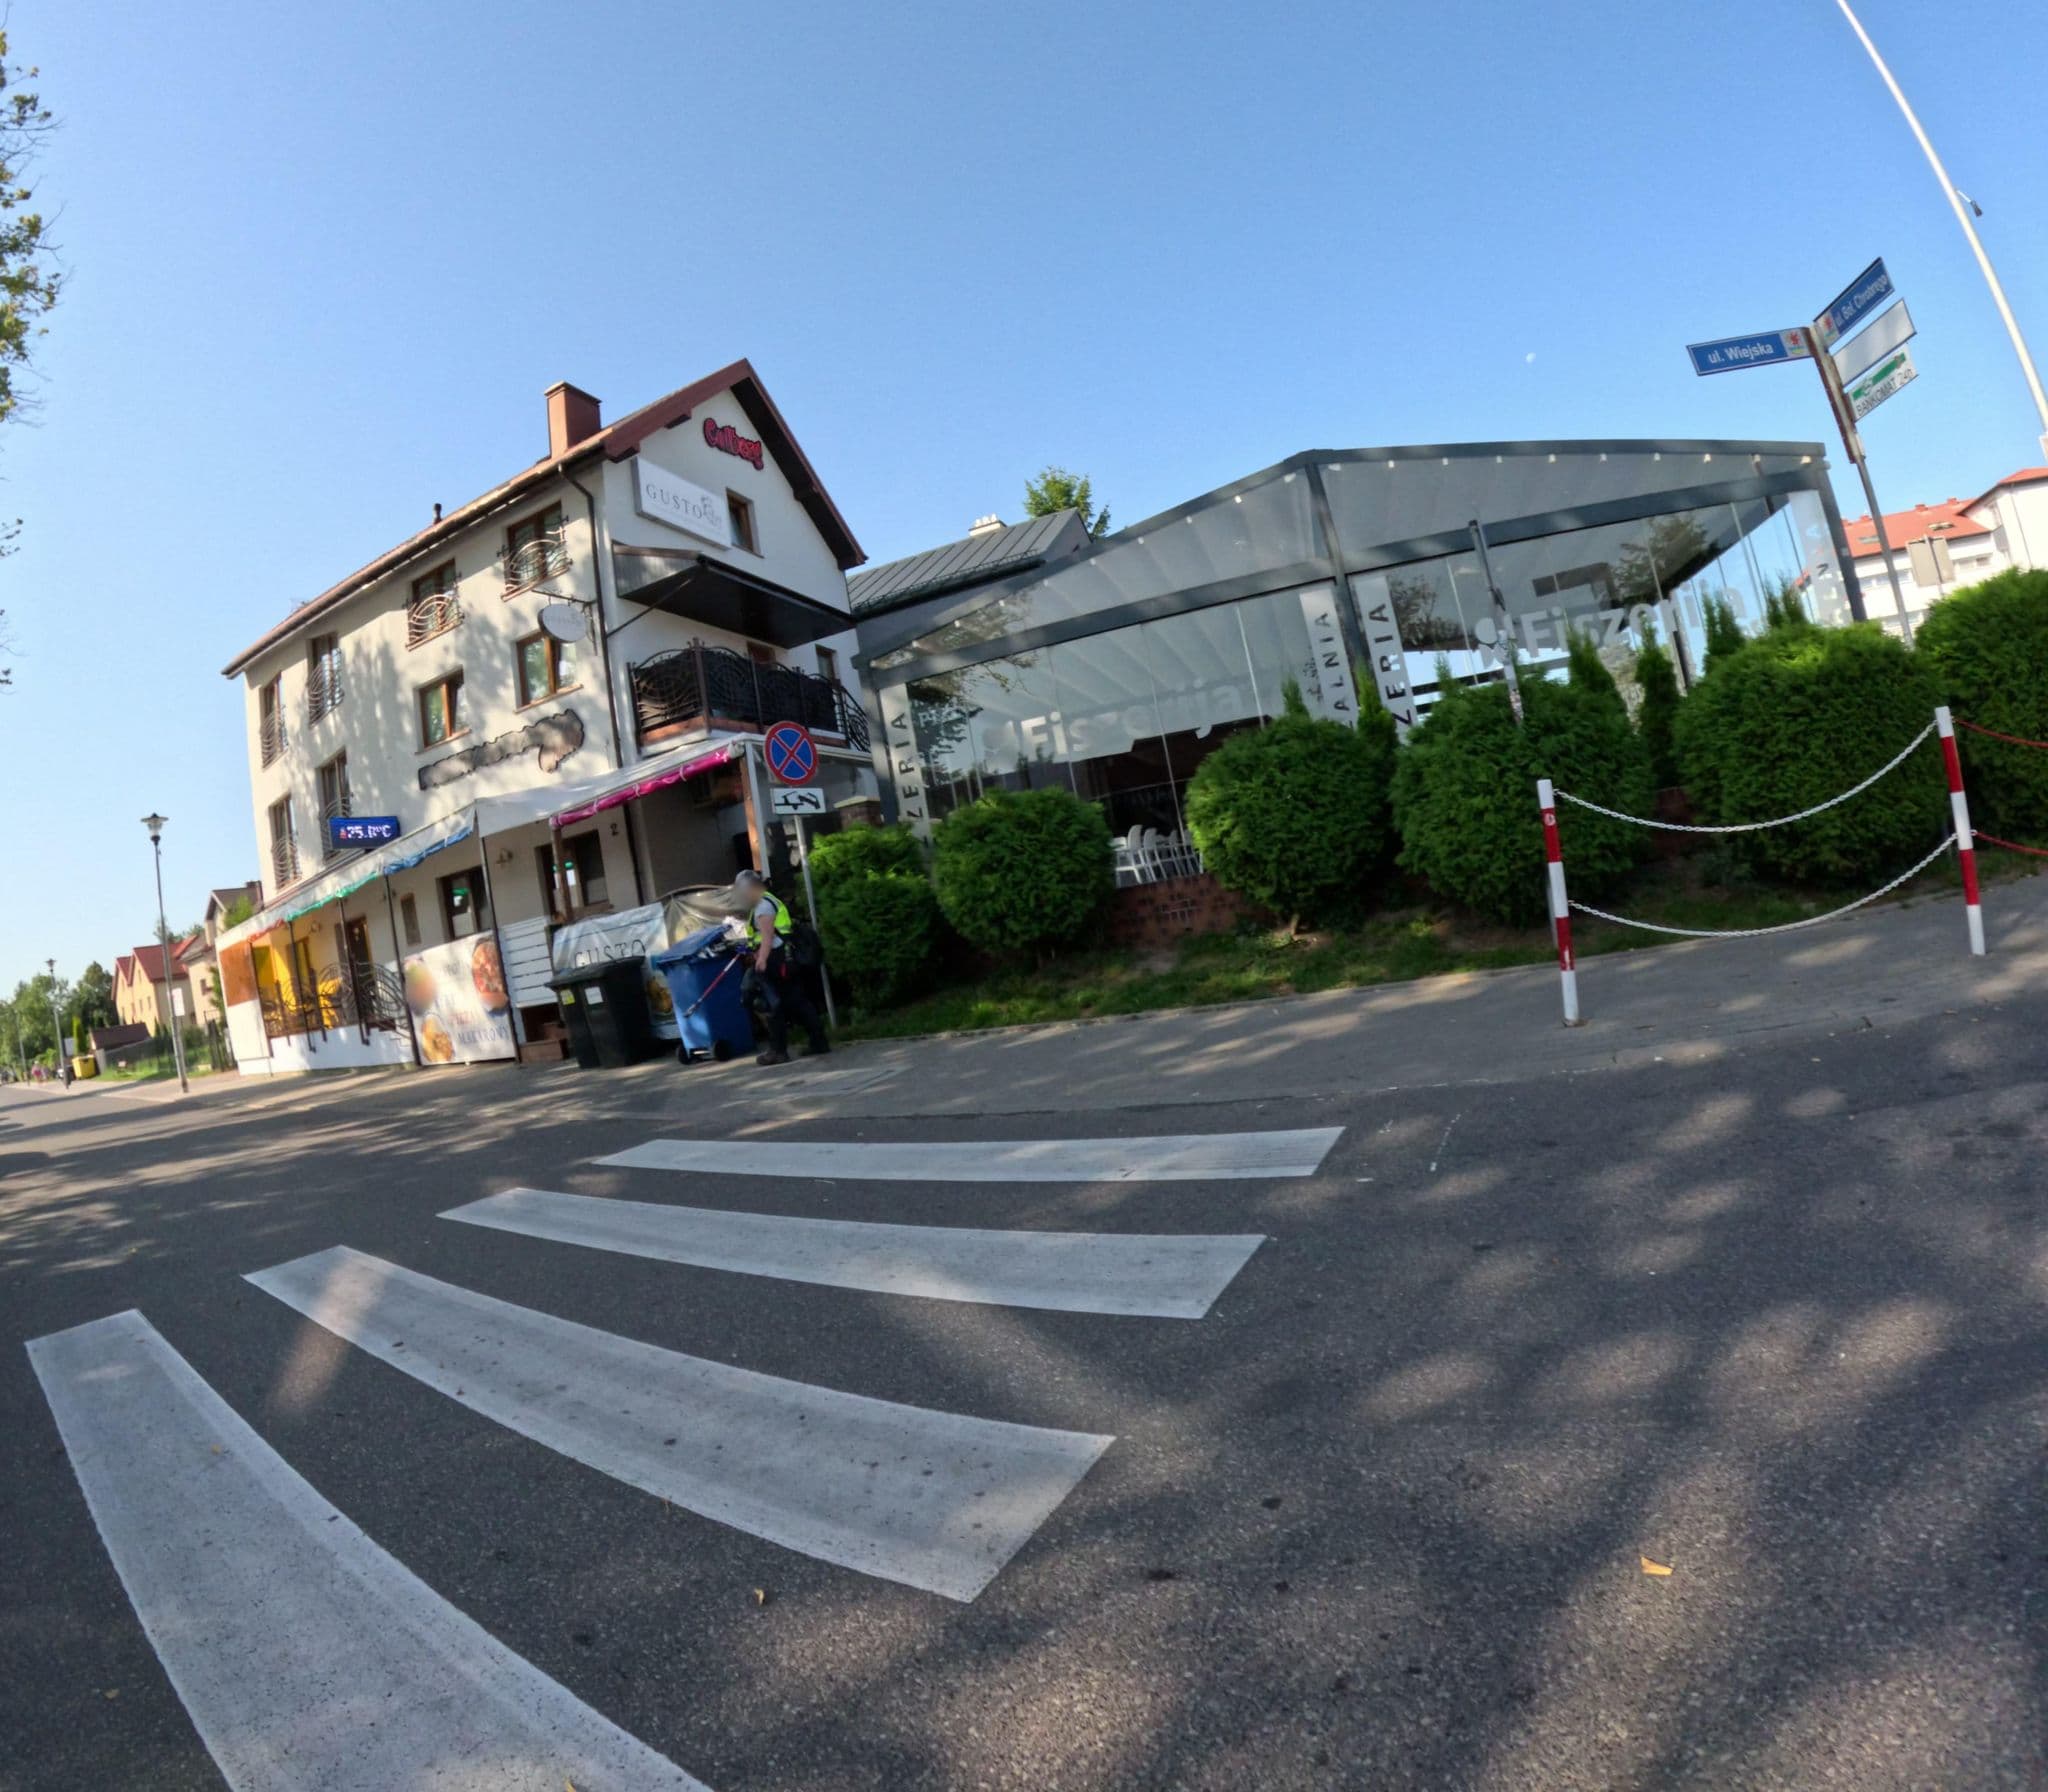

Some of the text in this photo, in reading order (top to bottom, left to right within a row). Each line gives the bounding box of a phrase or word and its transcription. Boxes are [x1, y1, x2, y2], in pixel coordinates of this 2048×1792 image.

[1707, 341, 1774, 364] ul. Wiejska
[646, 483, 703, 520] GUSTO
